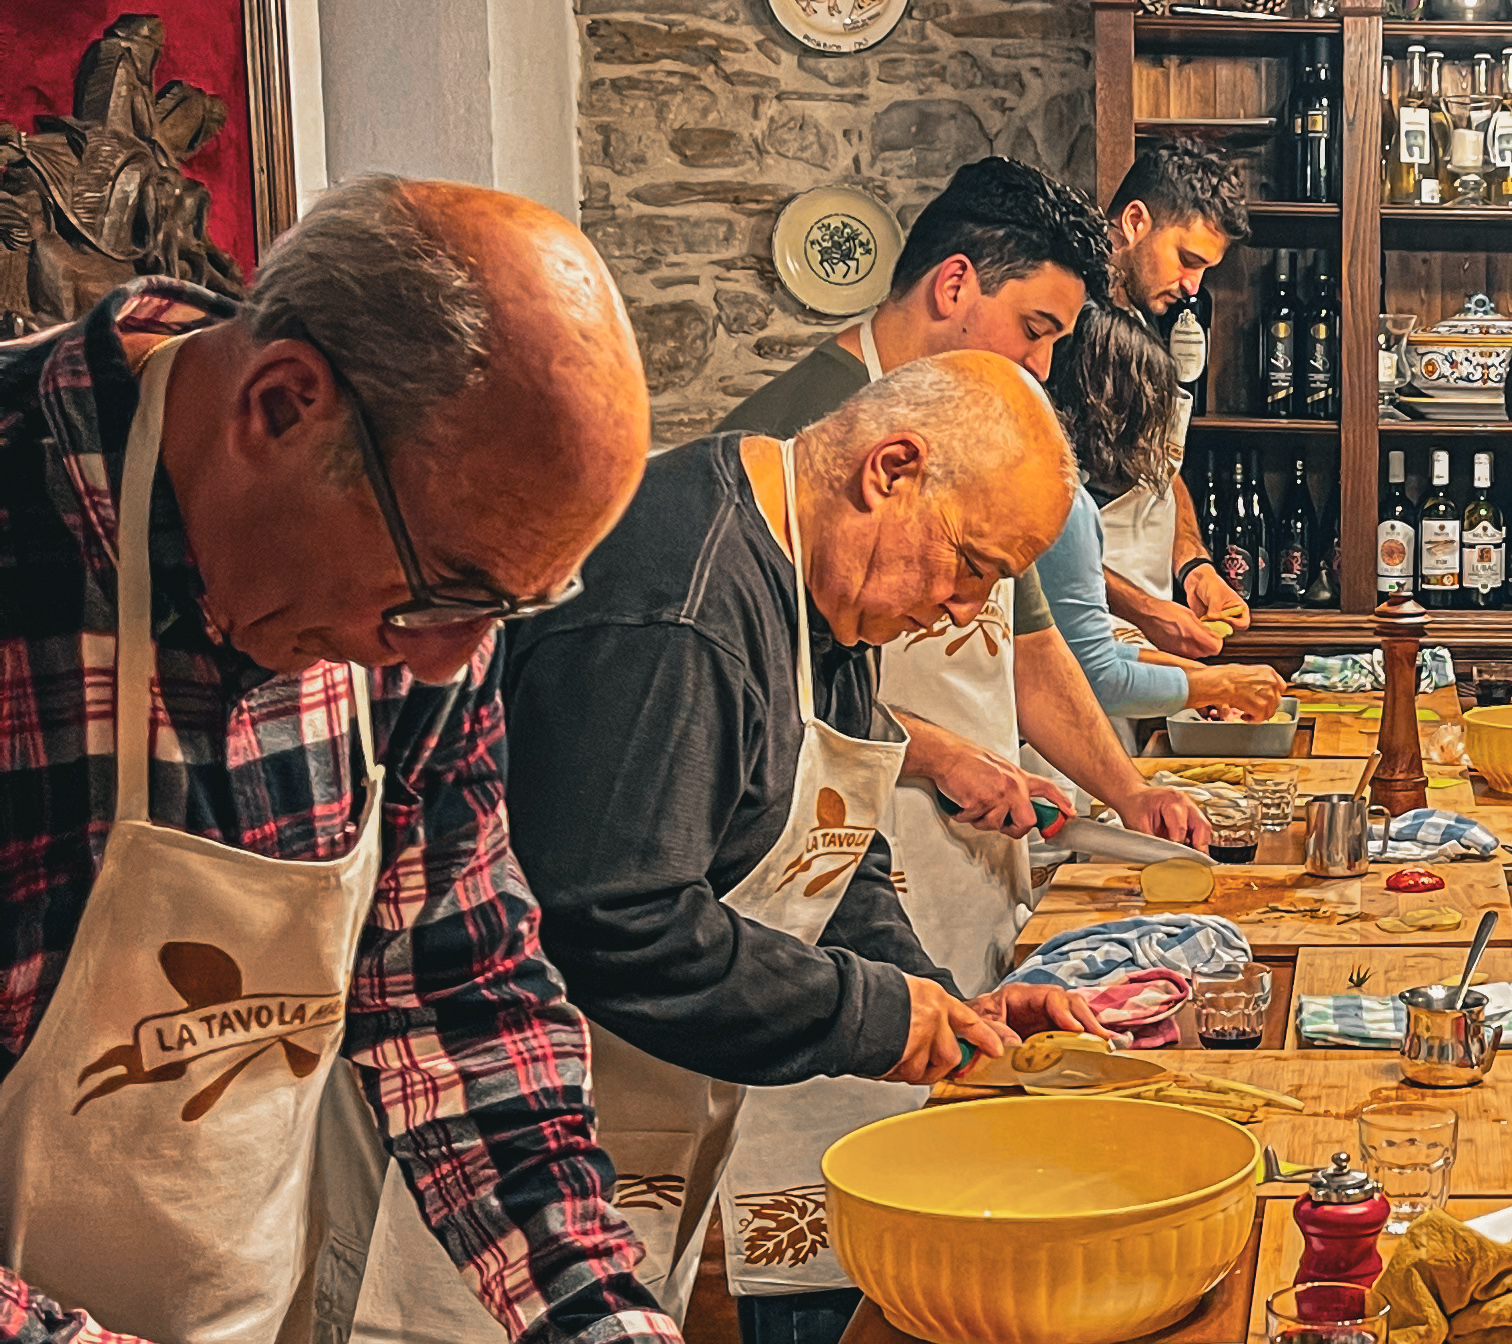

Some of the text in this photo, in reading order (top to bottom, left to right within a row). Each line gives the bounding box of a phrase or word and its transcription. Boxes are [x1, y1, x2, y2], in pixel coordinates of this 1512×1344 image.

[806, 836, 818, 853] LA
[156, 1024, 197, 1052] LA
[199, 1001, 307, 1039] TAVOLA
